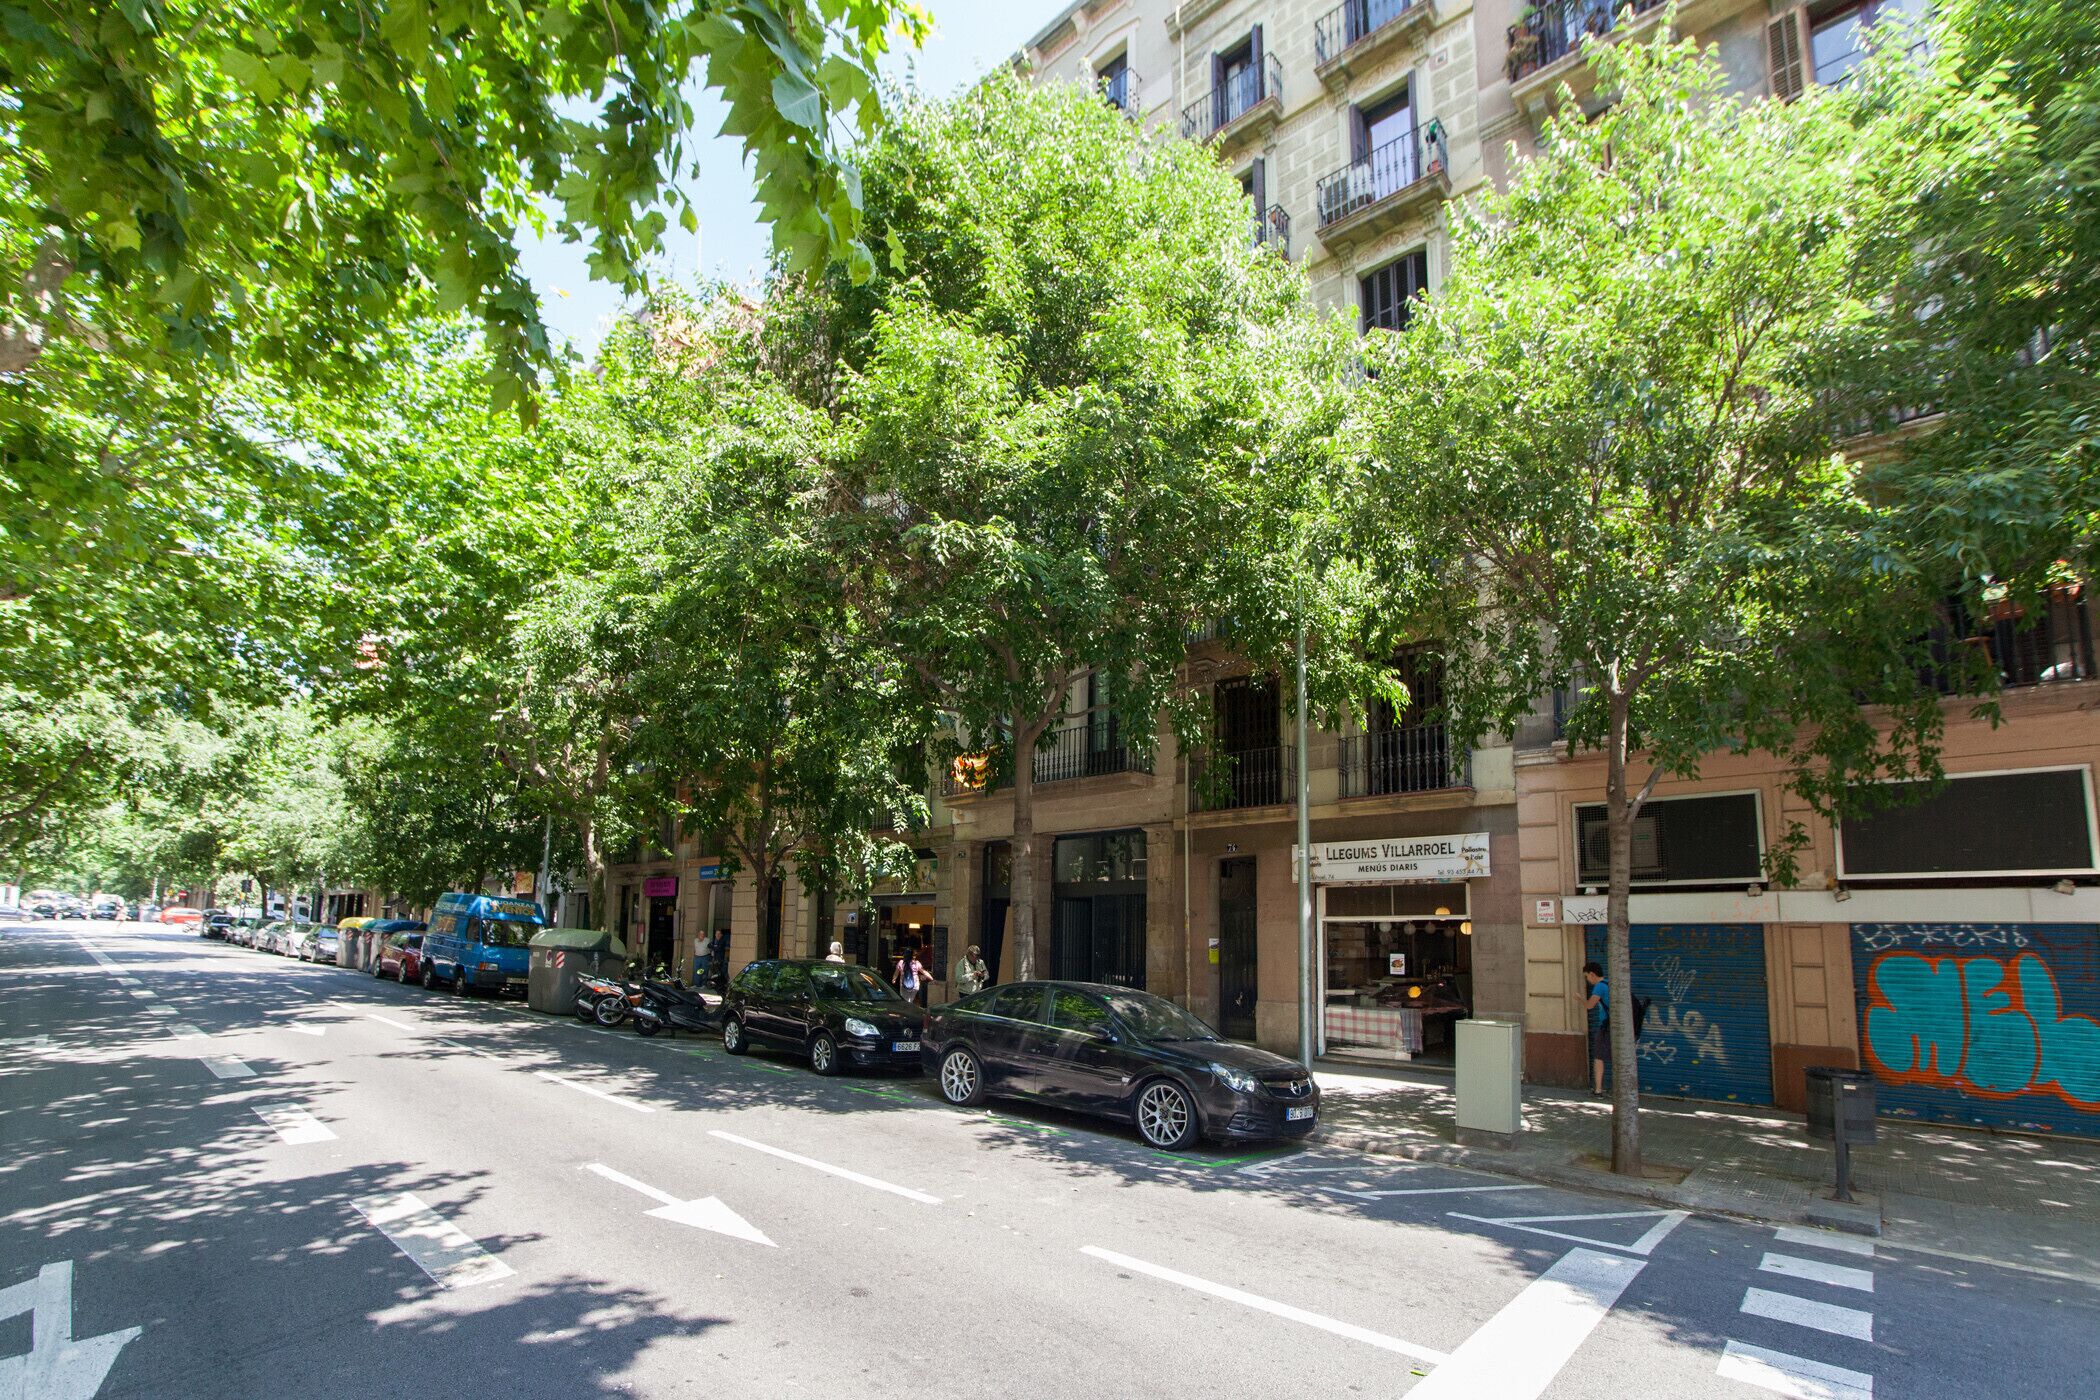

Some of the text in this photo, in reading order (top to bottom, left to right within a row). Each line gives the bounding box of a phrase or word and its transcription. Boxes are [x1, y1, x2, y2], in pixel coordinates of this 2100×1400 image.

[1326, 843, 1455, 860] LLEGUMS VILLARROEL
[1358, 863, 1418, 873] MENÚS DIARIS
